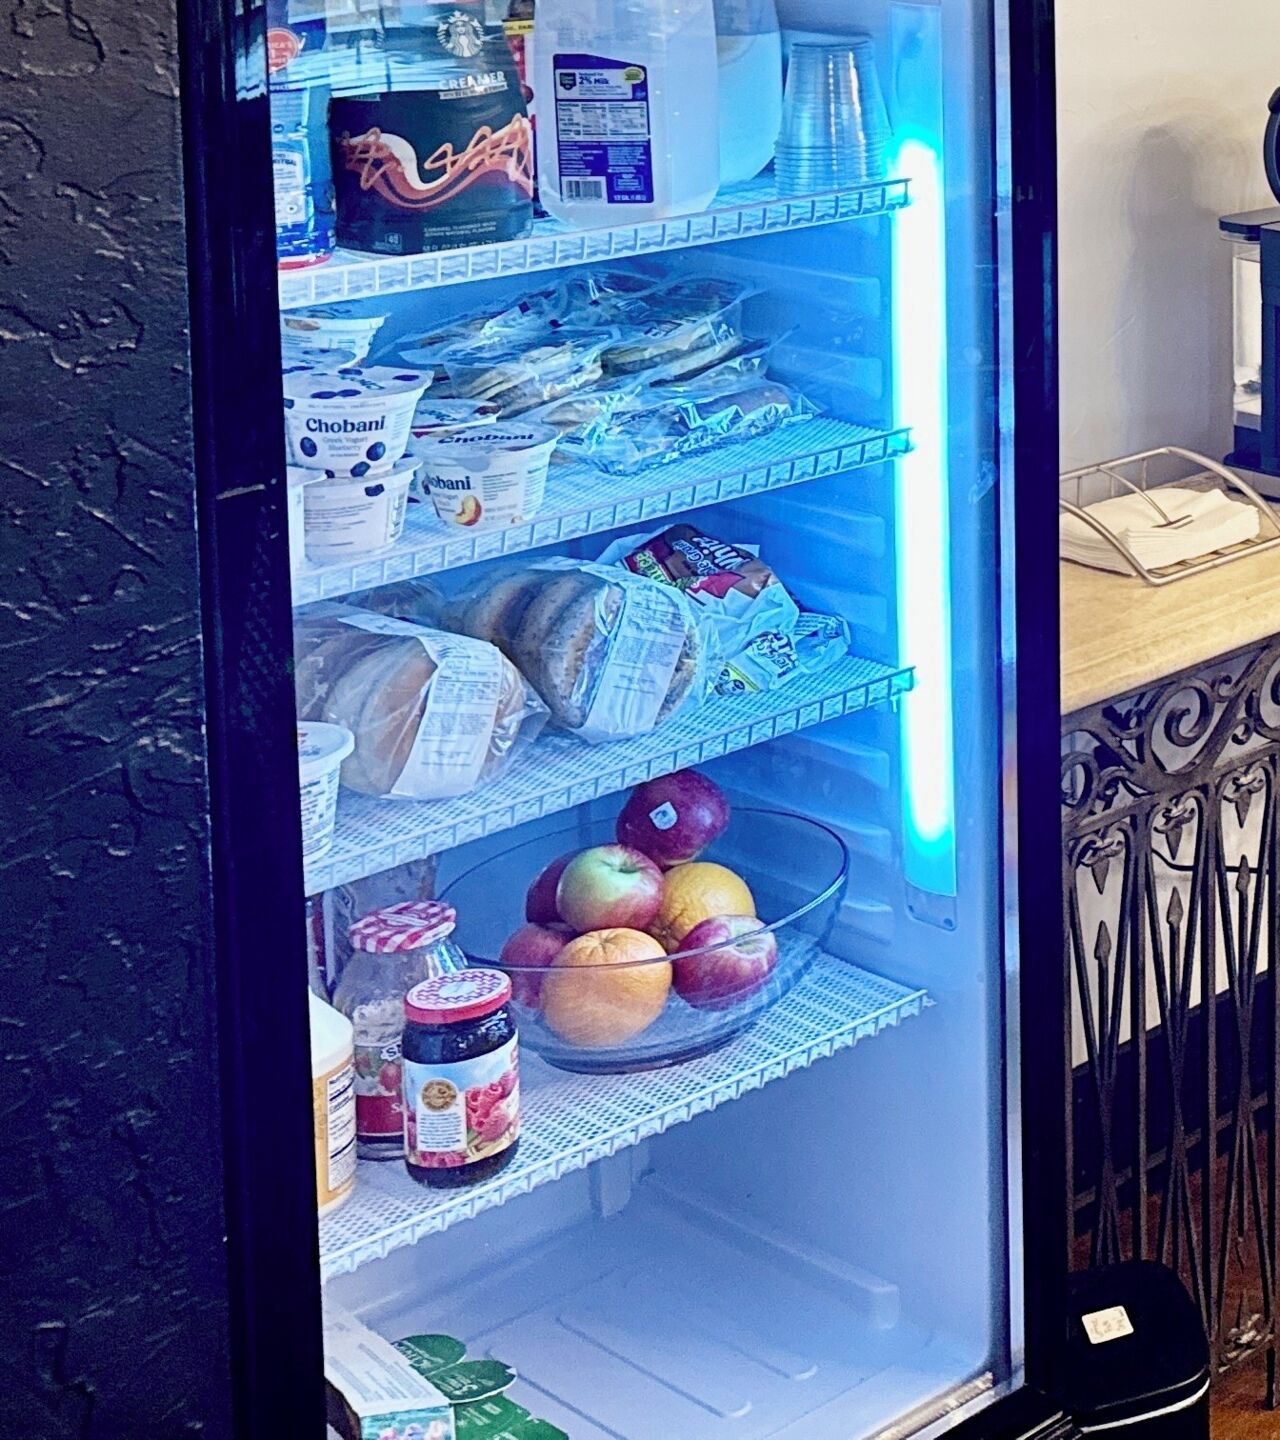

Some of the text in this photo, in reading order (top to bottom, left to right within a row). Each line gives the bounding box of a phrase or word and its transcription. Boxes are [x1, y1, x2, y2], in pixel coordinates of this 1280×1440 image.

[439, 70, 506, 90] CREAMER
[593, 77, 610, 85] Milk
[306, 415, 386, 433] Chobani
[438, 433, 535, 444] Chobani
[429, 475, 472, 491] obani
